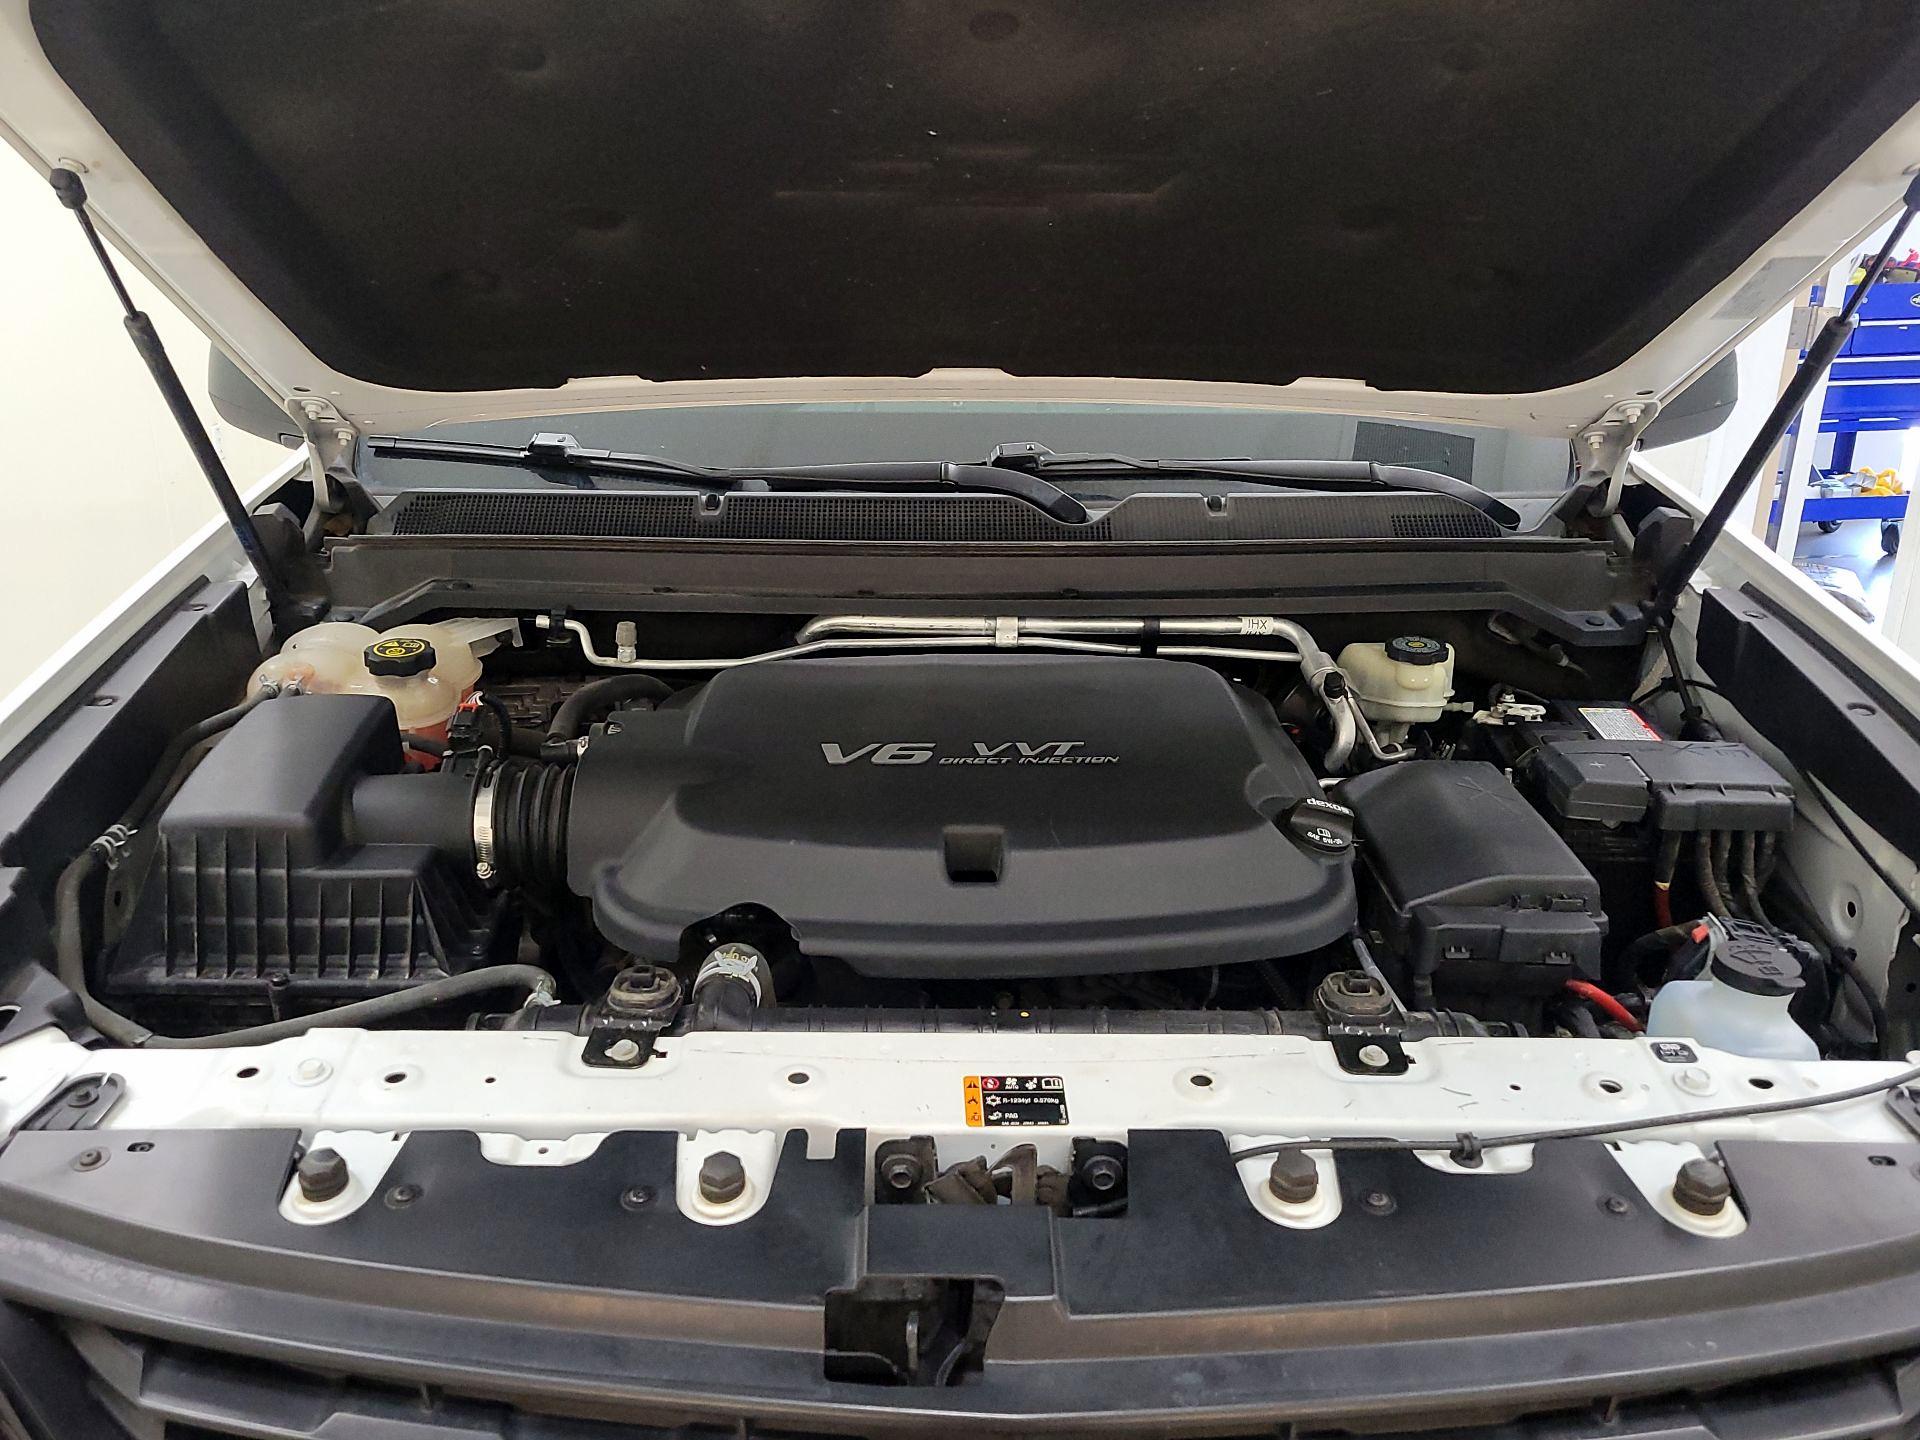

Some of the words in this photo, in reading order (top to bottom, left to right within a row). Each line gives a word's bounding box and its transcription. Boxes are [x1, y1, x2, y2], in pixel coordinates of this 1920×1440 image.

[821, 743, 937, 764] V6
[973, 741, 1085, 756] VVT
[939, 757, 1012, 765] DIRECT
[1018, 756, 1120, 764] INJECTION
[1306, 798, 1350, 814] dexos
